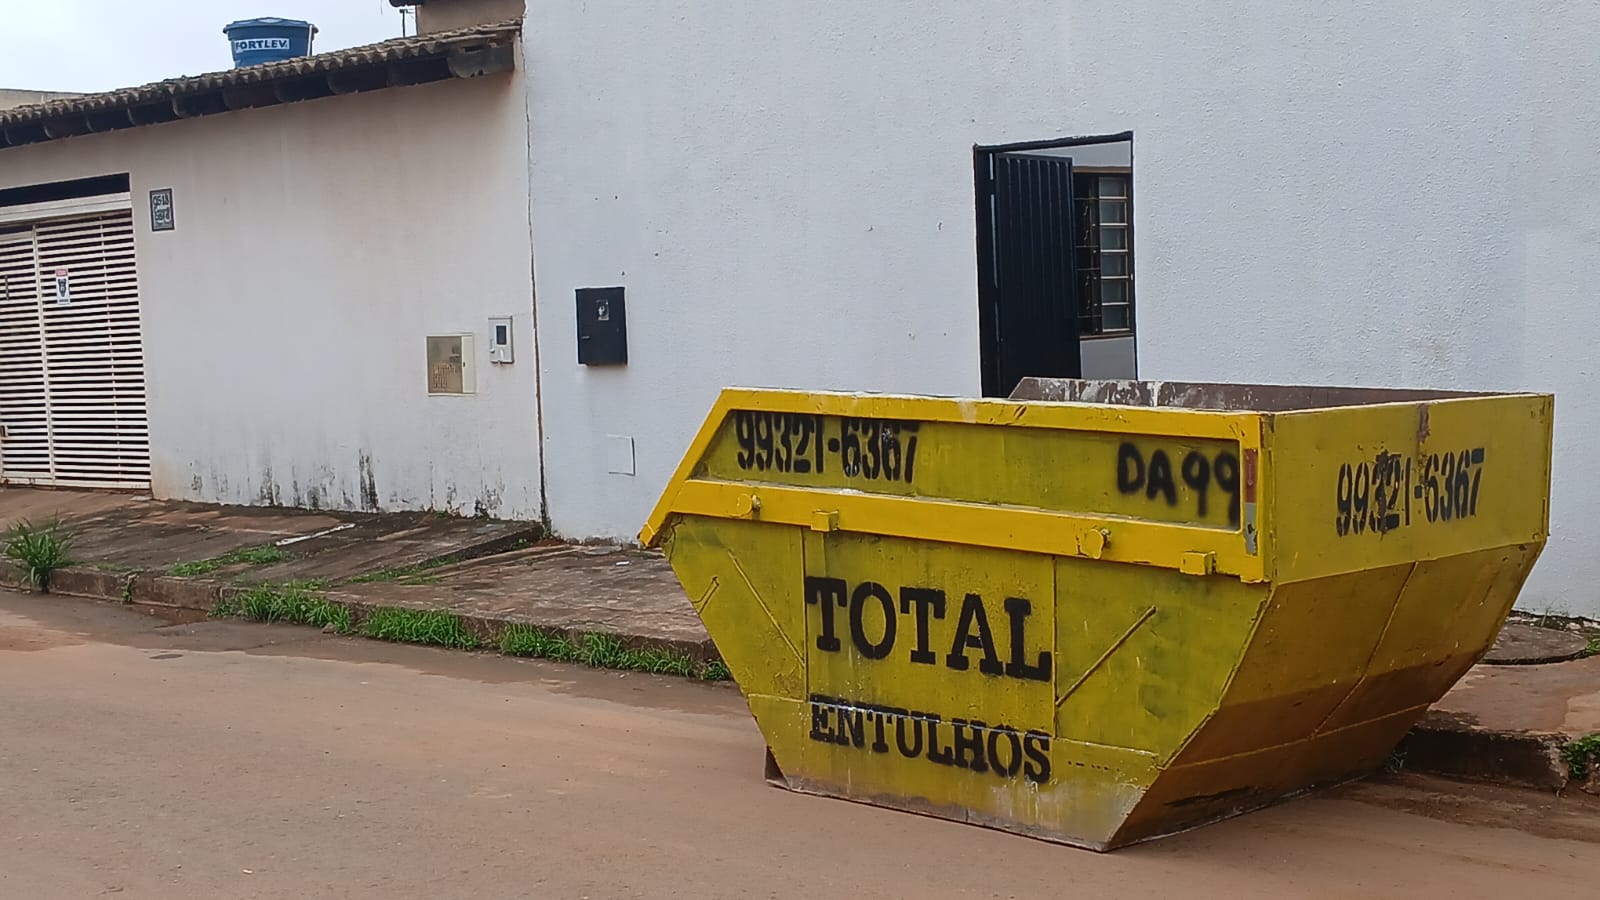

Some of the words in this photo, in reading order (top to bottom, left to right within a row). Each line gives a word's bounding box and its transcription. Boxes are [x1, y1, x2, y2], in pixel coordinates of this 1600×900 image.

[235, 39, 287, 50] FORTLEV
[735, 410, 920, 484] 99321-6367
[1117, 441, 1241, 526] DA99
[1336, 448, 1485, 537] 99321-6367
[806, 576, 1053, 682] TOTAL
[809, 693, 1052, 784] ENTULHOS
